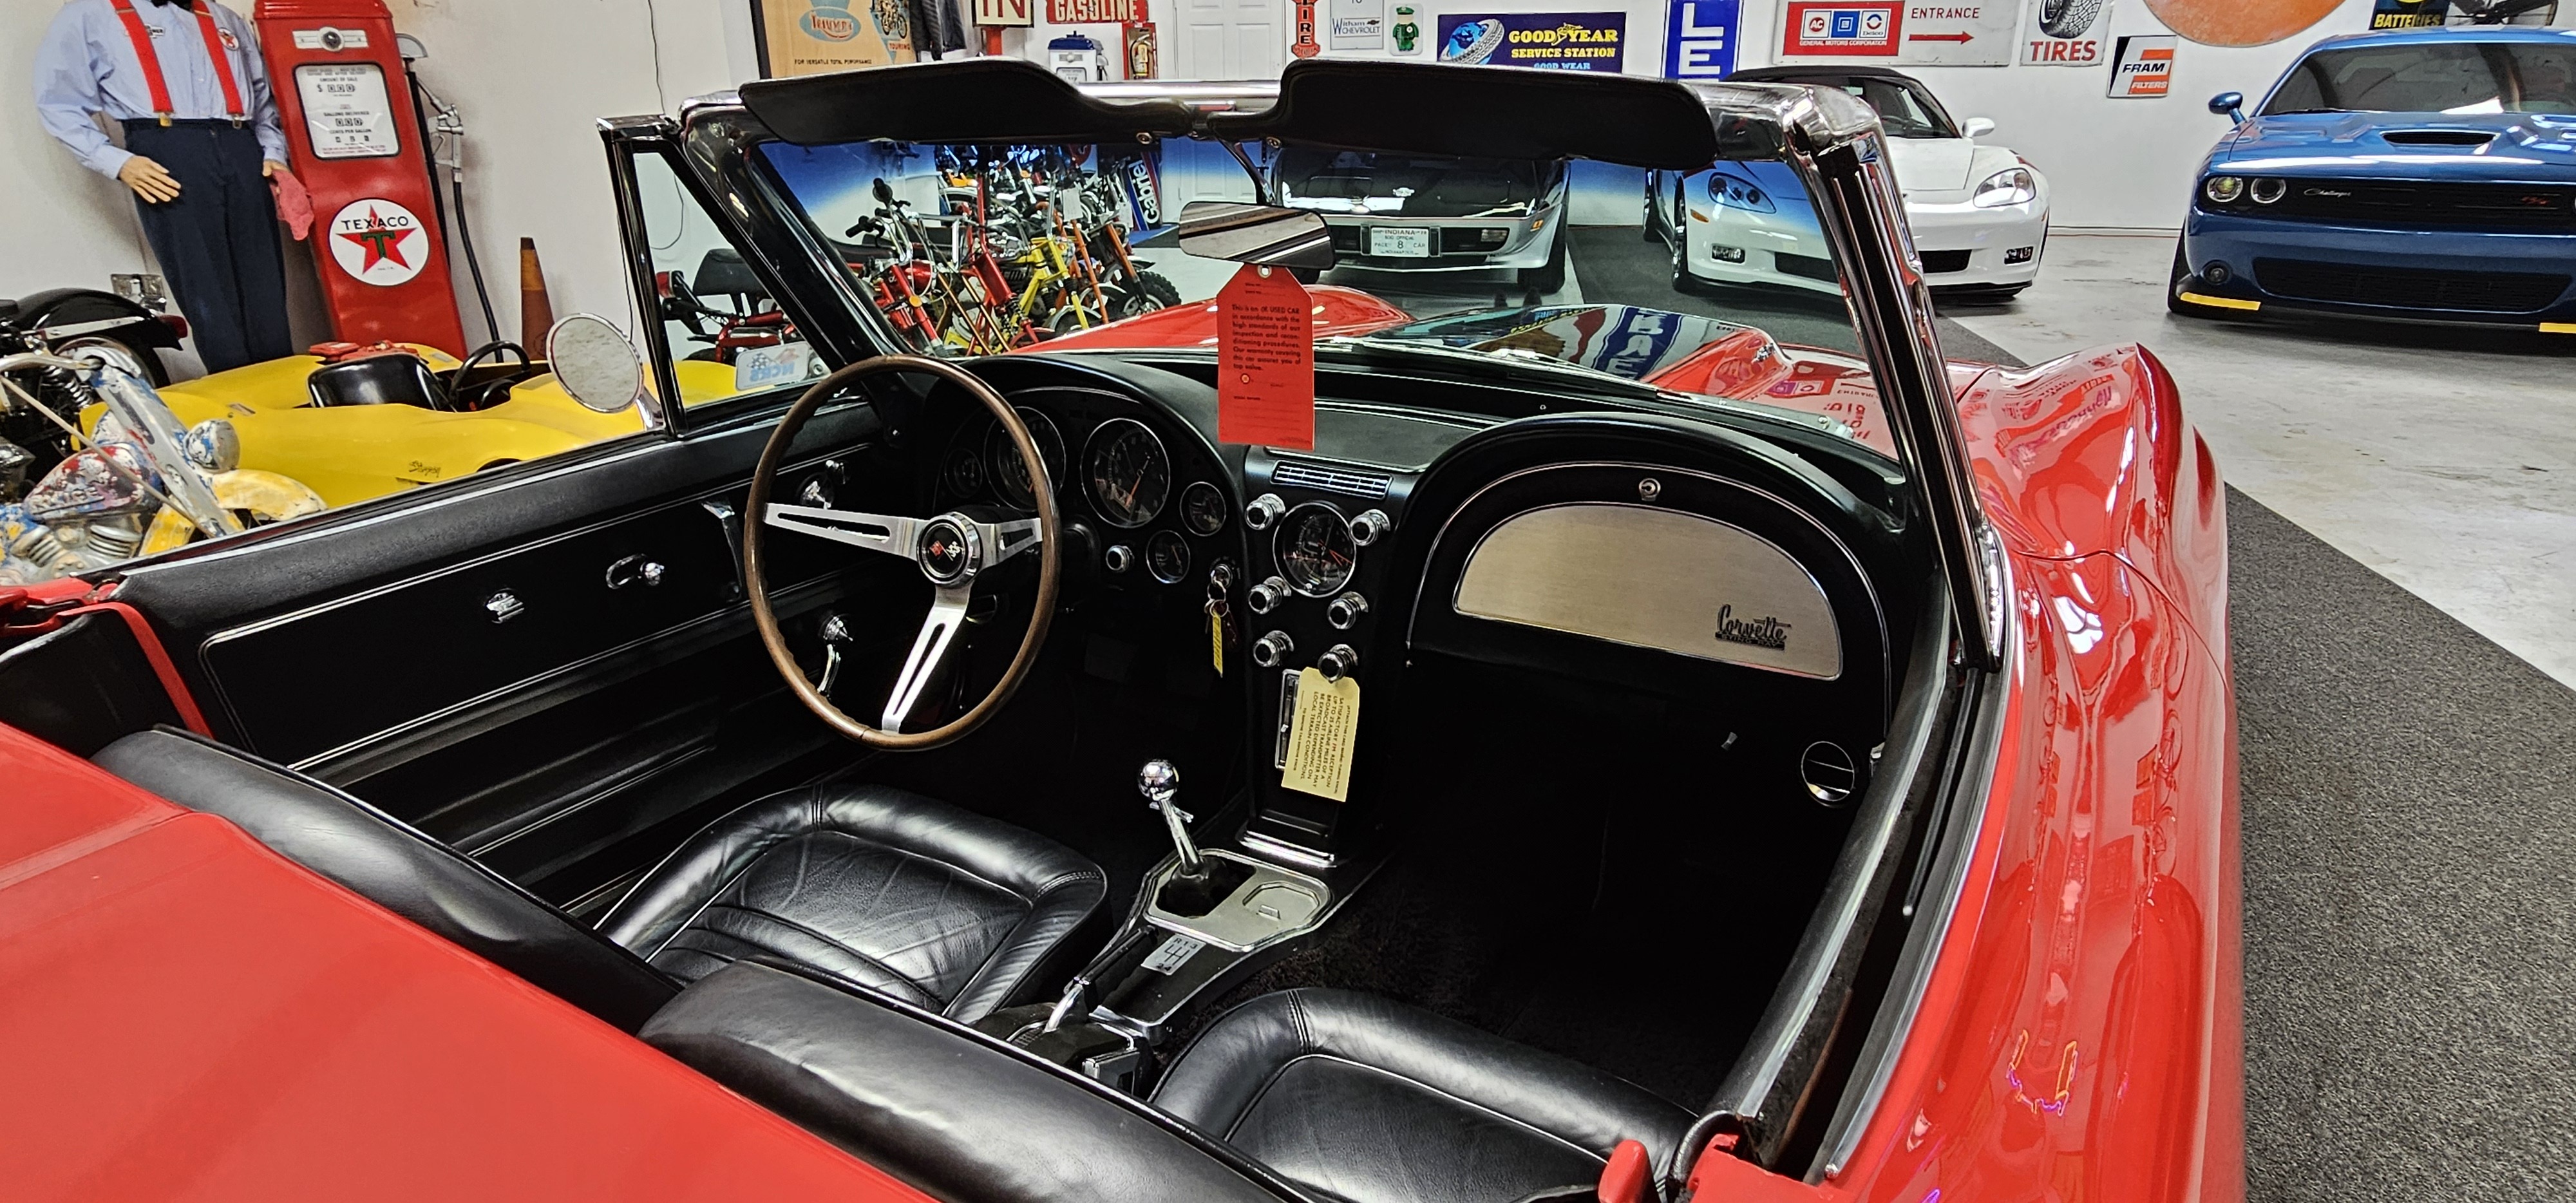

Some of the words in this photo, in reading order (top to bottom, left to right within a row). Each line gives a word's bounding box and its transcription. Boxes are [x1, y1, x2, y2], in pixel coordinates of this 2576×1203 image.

[1056, 0, 1139, 21] GASOLINE
[1911, 7, 1981, 19] ENTRANCE
[1299, 0, 1312, 44] IRE
[1332, 18, 1365, 35] Witham
[1810, 20, 1824, 29] AC
[2374, 14, 2441, 28] BATTERIES
[1678, 3, 1724, 76] LE
[1511, 48, 1562, 58] SERVICE
[1564, 48, 1616, 58] STATION
[2030, 41, 2097, 62] TIRES
[2123, 63, 2165, 73] FRAM
[2131, 81, 2168, 90] FILTERS
[1128, 159, 1160, 224] Gabriel
[341, 216, 409, 231] TEXACO
[1397, 240, 1404, 249] 8
[1232, 321, 1247, 329] high
[1717, 603, 1790, 640] Corvette
[1333, 696, 1338, 705] UP
[1315, 701, 1324, 732] EXPECTED
[1321, 694, 1331, 732] BROADCAST
[1331, 706, 1337, 715] TO
[1307, 714, 1316, 739] TERRAIN
[1333, 697, 1345, 741] SATISFACTORY
[1309, 733, 1318, 768] DEPENDING
[1316, 734, 1325, 773] TRANSMITTER
[1332, 743, 1337, 752] FM
[1307, 769, 1313, 779] ON
[1322, 765, 1327, 773] OF
[1326, 754, 1335, 788] RECEPTION
